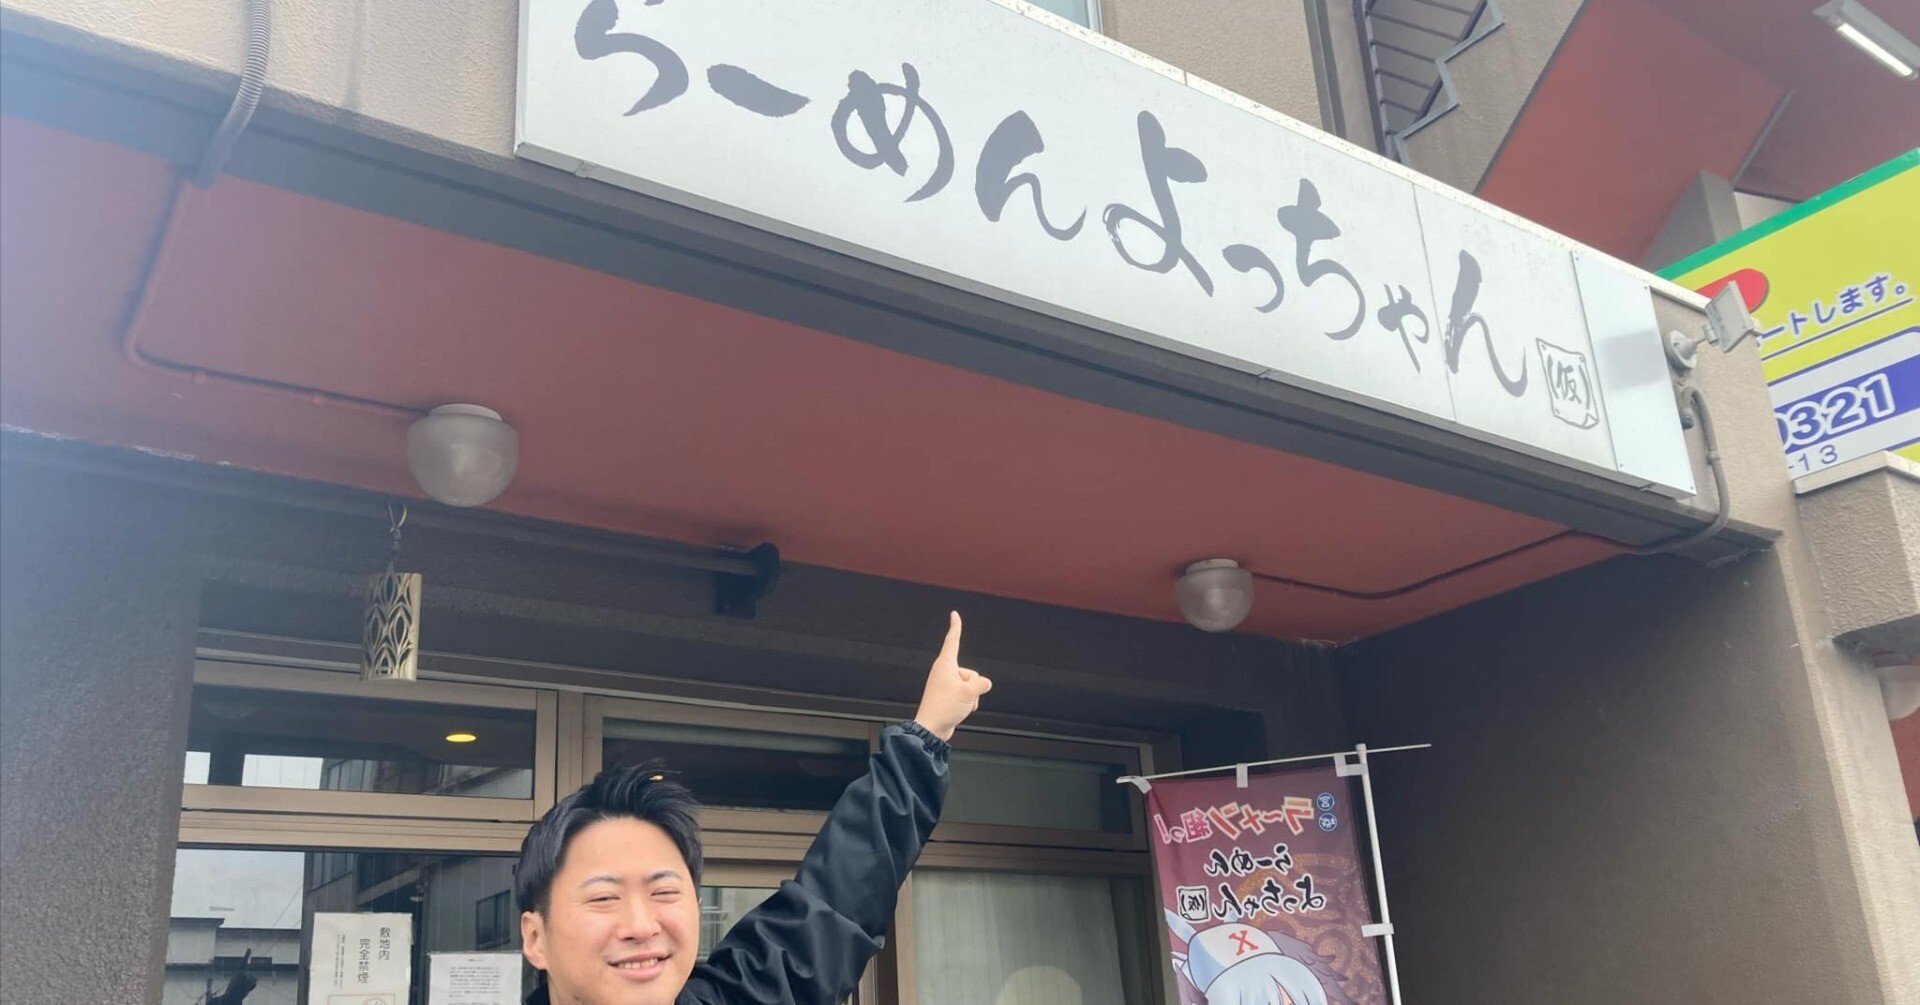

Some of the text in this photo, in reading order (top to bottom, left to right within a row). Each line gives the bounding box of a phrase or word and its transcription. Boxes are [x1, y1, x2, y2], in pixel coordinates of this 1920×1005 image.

[1757, 275, 1906, 347] ートします。
[357, 938, 371, 984] 完全禁煙
[378, 926, 391, 961] 敷地内
